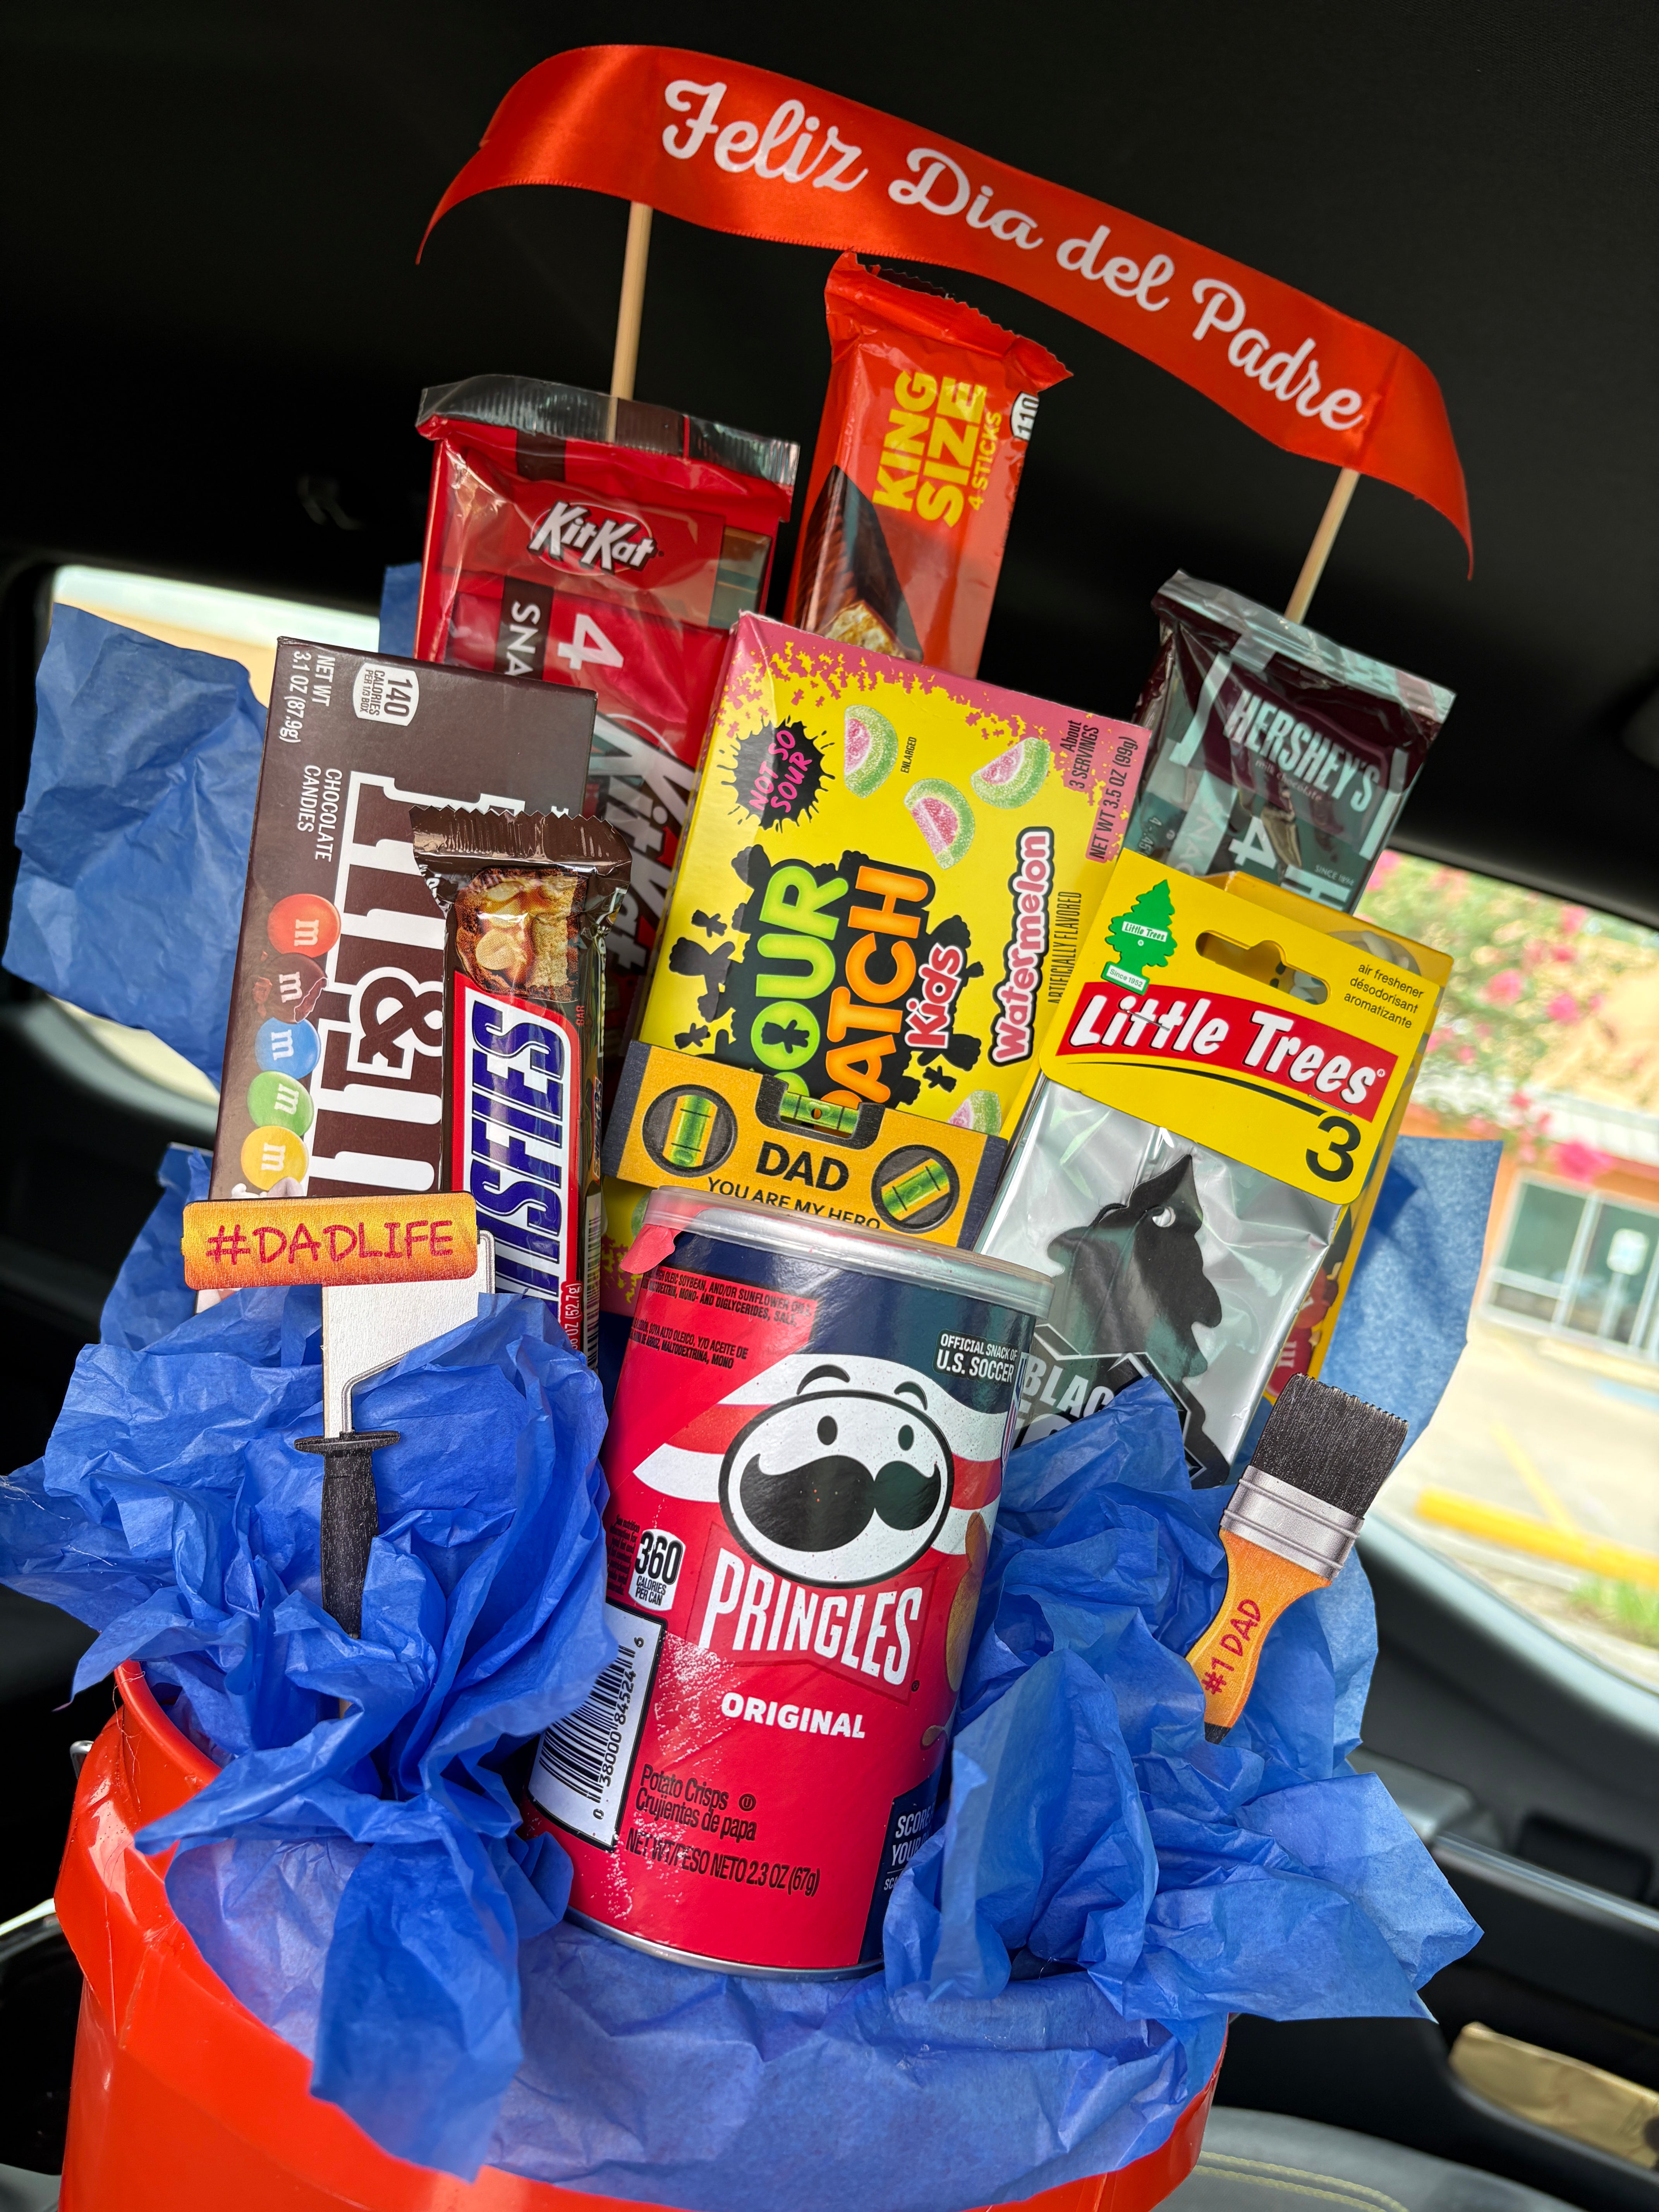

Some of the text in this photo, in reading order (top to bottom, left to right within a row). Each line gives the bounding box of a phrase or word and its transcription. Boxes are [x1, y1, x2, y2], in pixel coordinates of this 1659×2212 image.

[662, 79, 1365, 431] Feliz Dia del Padre
[872, 370, 938, 512] KING
[916, 376, 987, 528] SIZE
[968, 412, 1002, 511] 4 STICKS
[557, 613, 624, 670] 4
[279, 651, 312, 743] 3.1 OZ (87.9g)
[312, 655, 336, 706] NET WT
[359, 669, 374, 713] PER 1/3 BOX
[369, 670, 385, 716] CALORIES
[384, 679, 413, 717] 140
[900, 736, 917, 774] ENLARGED
[1060, 720, 1082, 753] About
[1069, 725, 1099, 789] 3 SERVINGS
[1223, 689, 1381, 813] HERSHEY'S
[749, 730, 795, 811] NOT SO
[770, 751, 812, 813] SOUR
[1255, 758, 1275, 773] milk
[297, 764, 322, 833] CANDIES
[314, 769, 343, 863] CHOCOLATE
[1089, 736, 1139, 859] NET WT 3.5 OZ (99g)
[1229, 816, 1278, 869] 4
[1314, 864, 1338, 880] SINCE
[295, 919, 319, 946] m
[1053, 891, 1082, 940] FLAVORED
[1124, 923, 1165, 941] Little Trees
[993, 831, 1049, 1063] Watermelon
[279, 970, 303, 1003] m
[750, 865, 849, 1096] OUR
[818, 865, 929, 1108] ATCH
[906, 942, 963, 1048] Kids
[1109, 969, 1143, 988] Since 1952
[1350, 977, 1419, 1014] désodorisant
[1358, 964, 1424, 999] air freshener
[575, 1005, 586, 1026] BAR
[1070, 994, 1230, 1056] Little
[1343, 993, 1412, 1029] aromatizante
[271, 1029, 294, 1061] m
[275, 1084, 298, 1116] m
[261, 1142, 286, 1172] m
[756, 1140, 849, 1192] DAD
[1305, 1114, 1362, 1183] 3
[708, 1176, 749, 1199] YOU
[751, 1189, 791, 1208] ARE
[794, 1199, 826, 1216] MY
[206, 1219, 454, 1266] #DADLIFE
[564, 1283, 583, 1320] (52.7g)
[678, 1274, 708, 1293] SOYBEAN,
[708, 1281, 737, 1298] AND/OR
[738, 1288, 790, 1311] SUNFLOWER
[699, 1292, 715, 1306] AND
[715, 1296, 771, 1321] DIGLYCERIDES,
[659, 1326, 673, 1340] ALTO
[697, 1336, 710, 1350] Y/O
[709, 1339, 736, 1357] ACEITE
[736, 1346, 749, 1360] DE
[661, 1339, 710, 1365] MALTODEXTRINA,
[711, 1353, 734, 1369] MONO
[936, 1349, 1015, 1383] U.S. SOCCER
[940, 1333, 1018, 1362] OFFICIAL SNACK OF
[634, 1530, 684, 1585] 360
[635, 1587, 664, 1606] PER CAN
[636, 1575, 667, 1596] CALORIES
[696, 1547, 923, 1685] PRINGLES
[1201, 1599, 1261, 1695] #1 DAD
[598, 1731, 623, 1788] 38000
[613, 1670, 636, 1725] 84524
[633, 1637, 644, 1648] 6
[721, 1692, 866, 1739] ORIGINAL
[640, 1764, 730, 1812] Potato Crisps
[635, 1787, 758, 1843] Crujientes de papa
[895, 1807, 932, 1839] SCORE
[625, 1827, 653, 1857] NET
[709, 1853, 747, 1883] NETO
[746, 1861, 769, 1887] 2.3
[768, 1863, 790, 1890] OZ
[787, 1865, 821, 1898] (67g)
